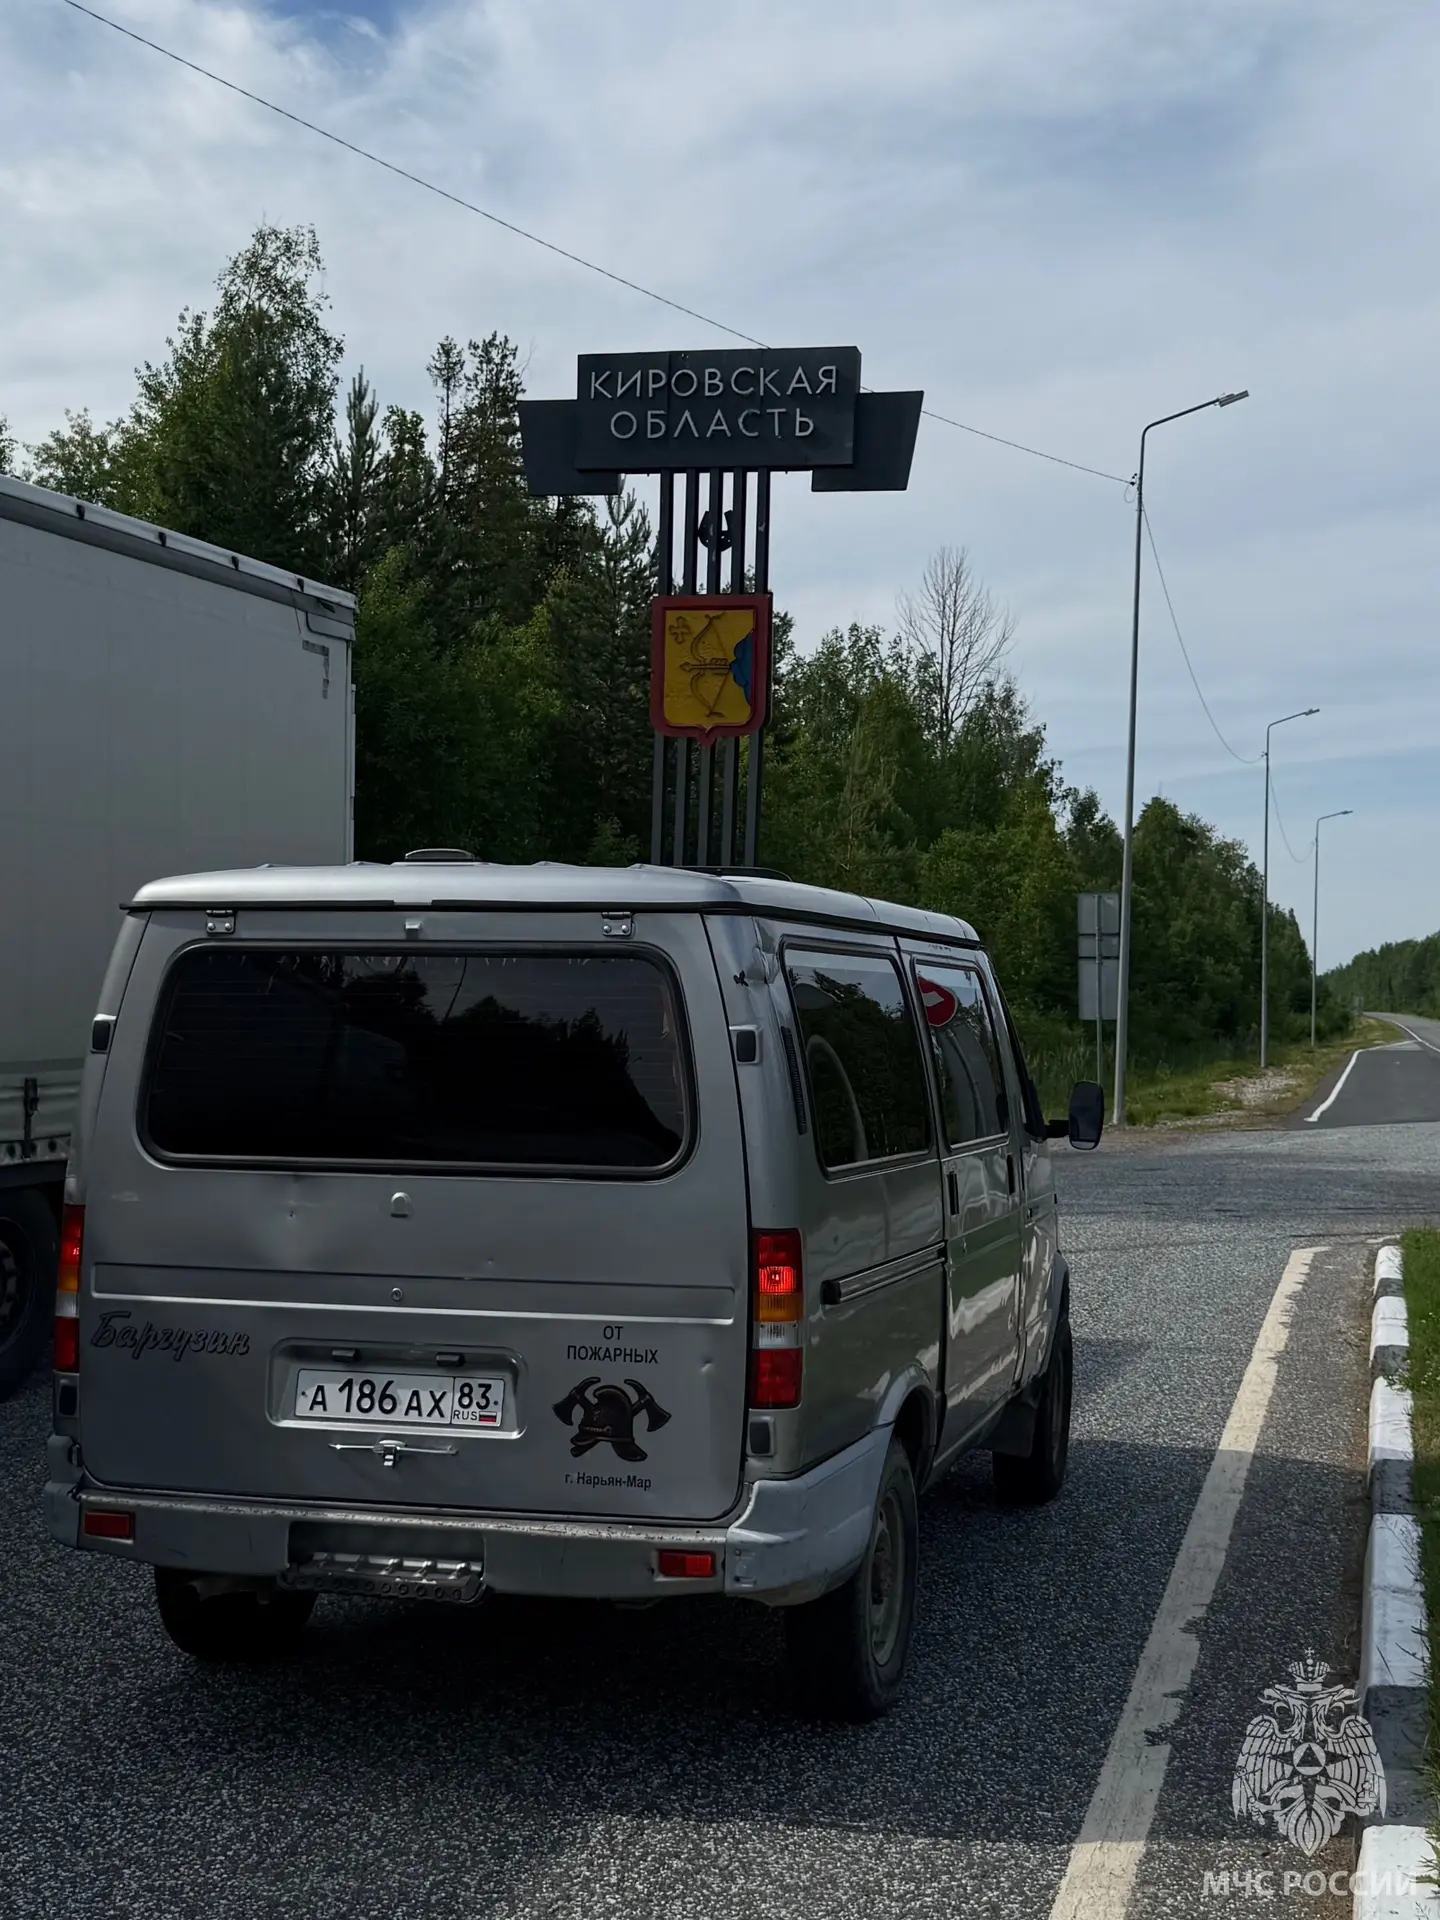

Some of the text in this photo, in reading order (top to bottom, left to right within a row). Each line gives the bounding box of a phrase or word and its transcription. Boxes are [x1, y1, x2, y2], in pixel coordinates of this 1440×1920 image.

[590, 365, 837, 399] КИРОВСКАЯ
[610, 408, 815, 439] ОБЛАСТЬ
[90, 1310, 251, 1362] Баргузин
[603, 1325, 624, 1340] ОТ
[567, 1345, 659, 1364] ПОЖАРНЫХ
[458, 1383, 492, 1410] 83
[453, 1410, 478, 1421] RUS
[564, 1472, 652, 1491] г. Нарьян-Мар
